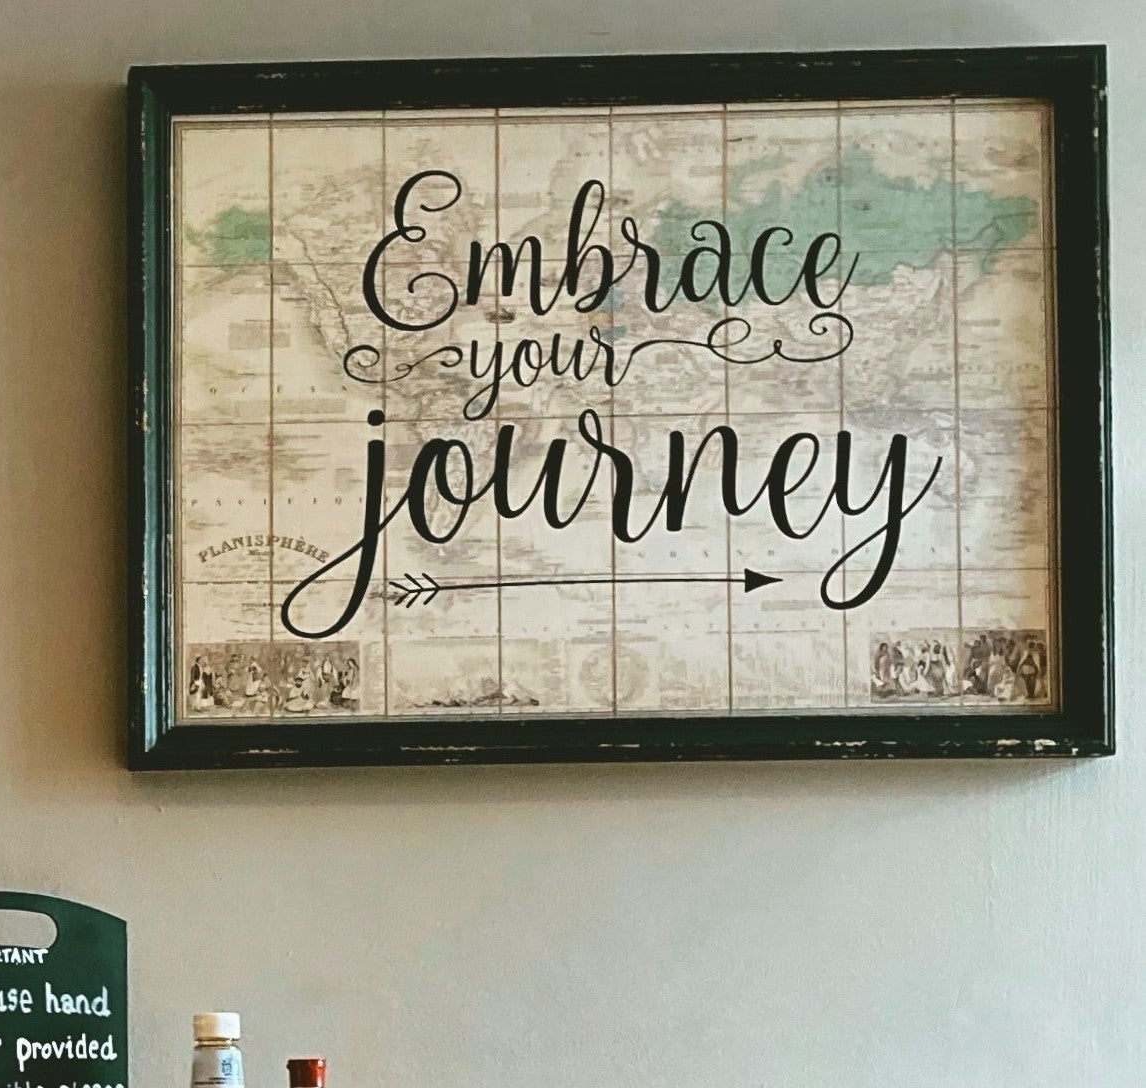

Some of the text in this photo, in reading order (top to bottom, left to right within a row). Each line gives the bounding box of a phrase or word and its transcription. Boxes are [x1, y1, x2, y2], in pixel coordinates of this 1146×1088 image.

[362, 169, 860, 332] Embrace
[281, 409, 944, 639] journey
[198, 535, 331, 564] PLANISPHÈRE
[45, 981, 111, 1017] hand
[16, 1033, 118, 1072] provided
